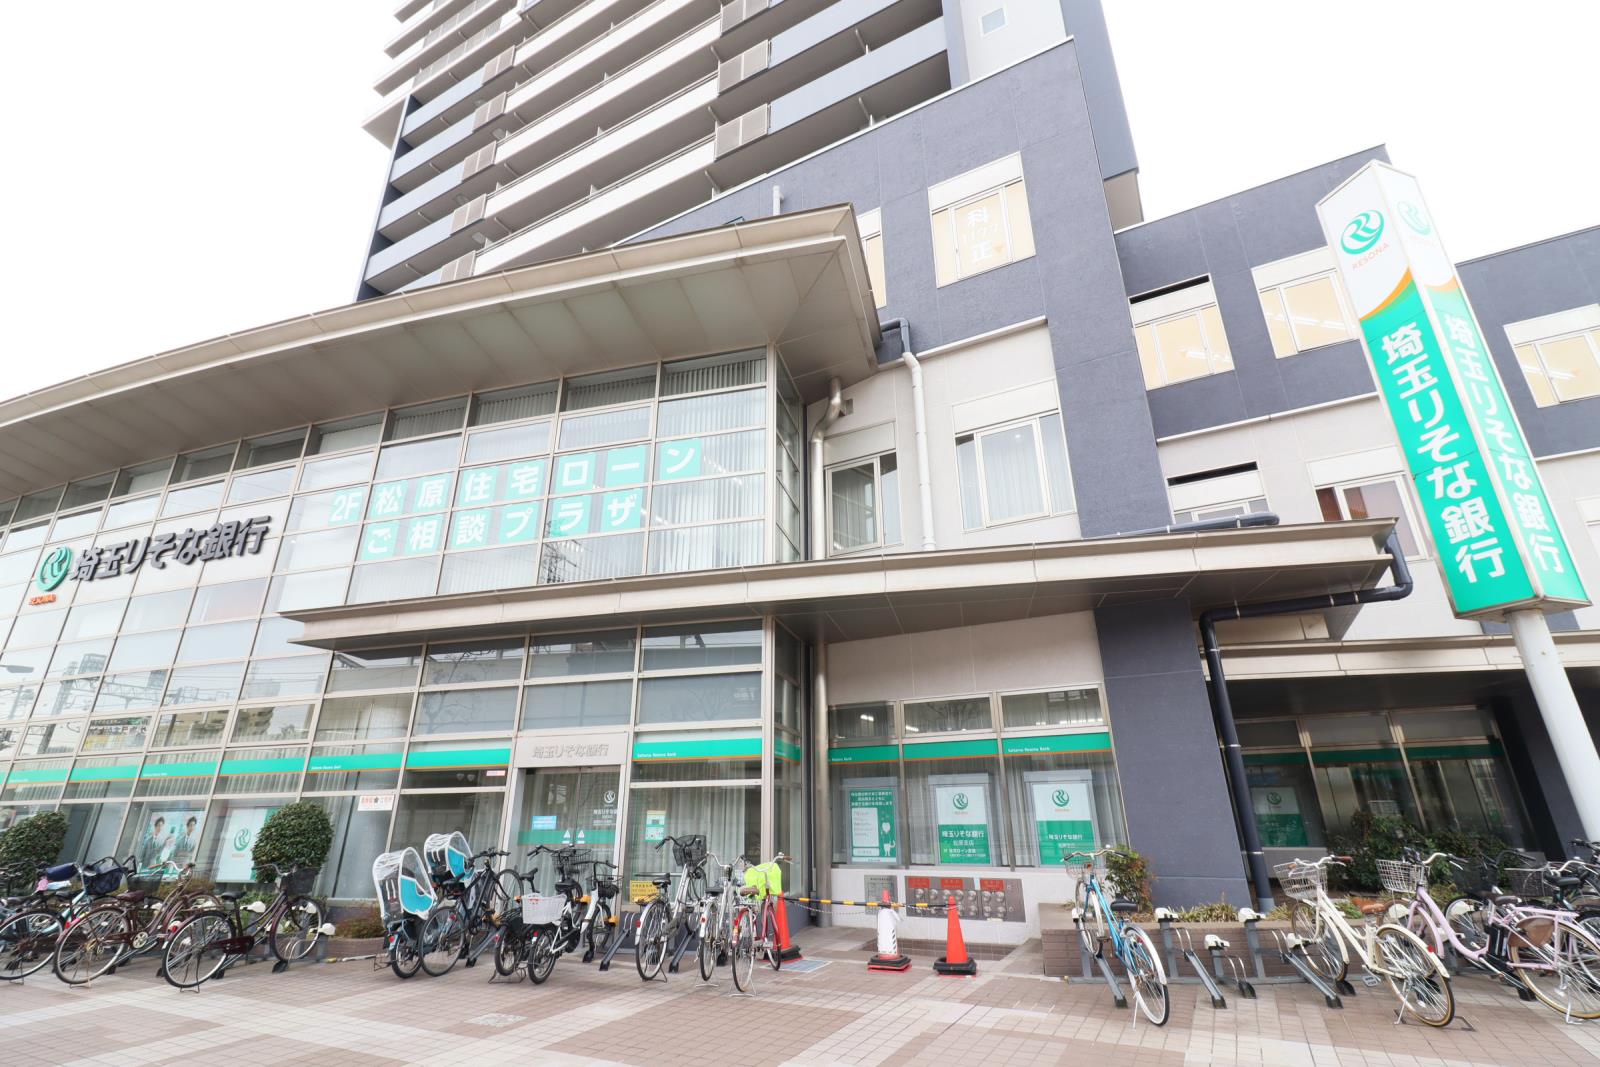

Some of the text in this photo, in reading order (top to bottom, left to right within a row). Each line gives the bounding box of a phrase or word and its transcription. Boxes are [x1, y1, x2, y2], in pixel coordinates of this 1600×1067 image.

[1352, 242, 1390, 270] RESONA
[1381, 322, 1506, 583] 埼玉りそな銀行
[1444, 315, 1564, 573] 埼玉りそな銀行
[69, 515, 271, 582] 埼玉りそな銀行
[367, 496, 636, 555] ご相談プラザ
[532, 743, 609, 759] 埼玉りそな銀行
